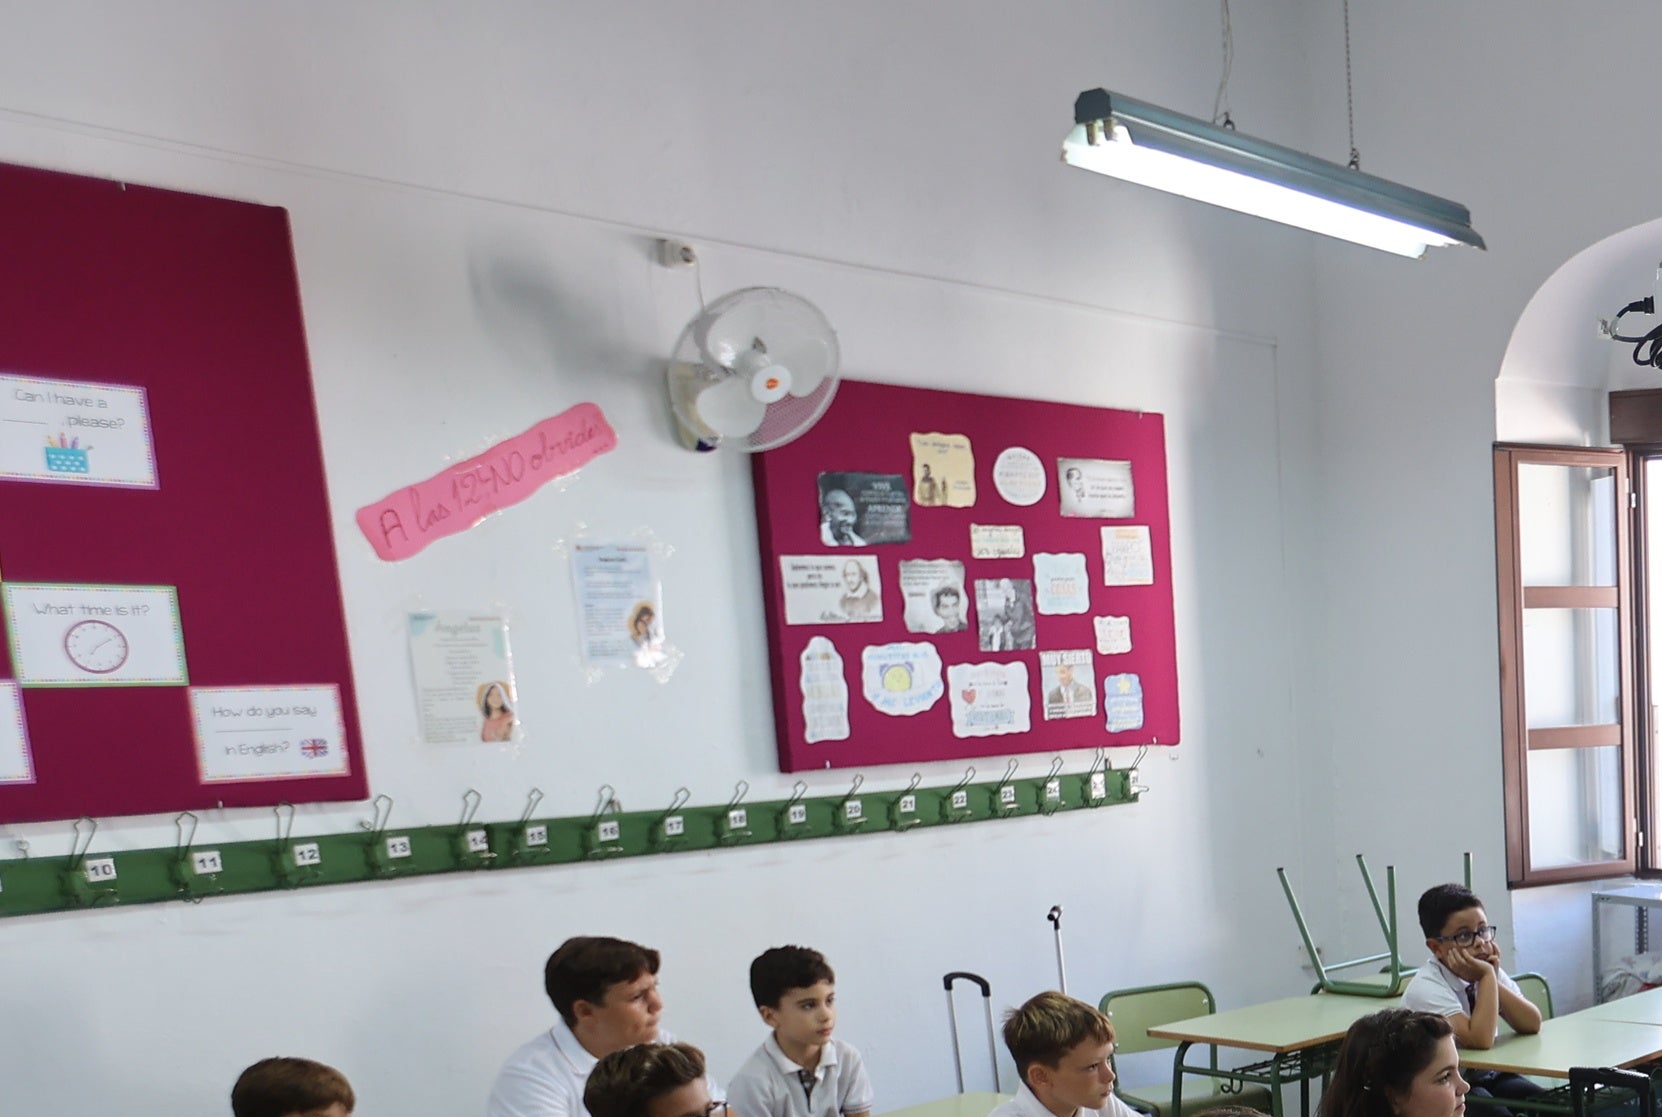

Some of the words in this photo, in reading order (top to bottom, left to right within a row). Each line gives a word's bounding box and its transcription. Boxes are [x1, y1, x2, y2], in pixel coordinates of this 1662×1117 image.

[15, 388, 45, 403] Can
[54, 391, 93, 408] have
[98, 398, 108, 409] a
[380, 508, 409, 549] A
[408, 486, 451, 532] las
[488, 450, 525, 494] NO
[33, 602, 74, 616] What
[80, 603, 111, 616] time
[115, 604, 128, 616] is
[132, 603, 150, 616] it?
[212, 706, 242, 717] How
[247, 706, 262, 716] do
[265, 707, 289, 718] you
[293, 706, 317, 717] say
[1003, 788, 1014, 799] 23
[903, 799, 914, 810] 21
[954, 795, 966, 805] 22
[791, 808, 805, 820] 19
[848, 804, 860, 815] 20
[732, 813, 745, 825] 18
[602, 825, 616, 837] 16
[667, 820, 682, 832] 17
[530, 830, 544, 842] 15
[391, 841, 408, 853] 13
[298, 849, 318, 861] 12
[198, 856, 218, 869] 11
[90, 863, 113, 877] 10
